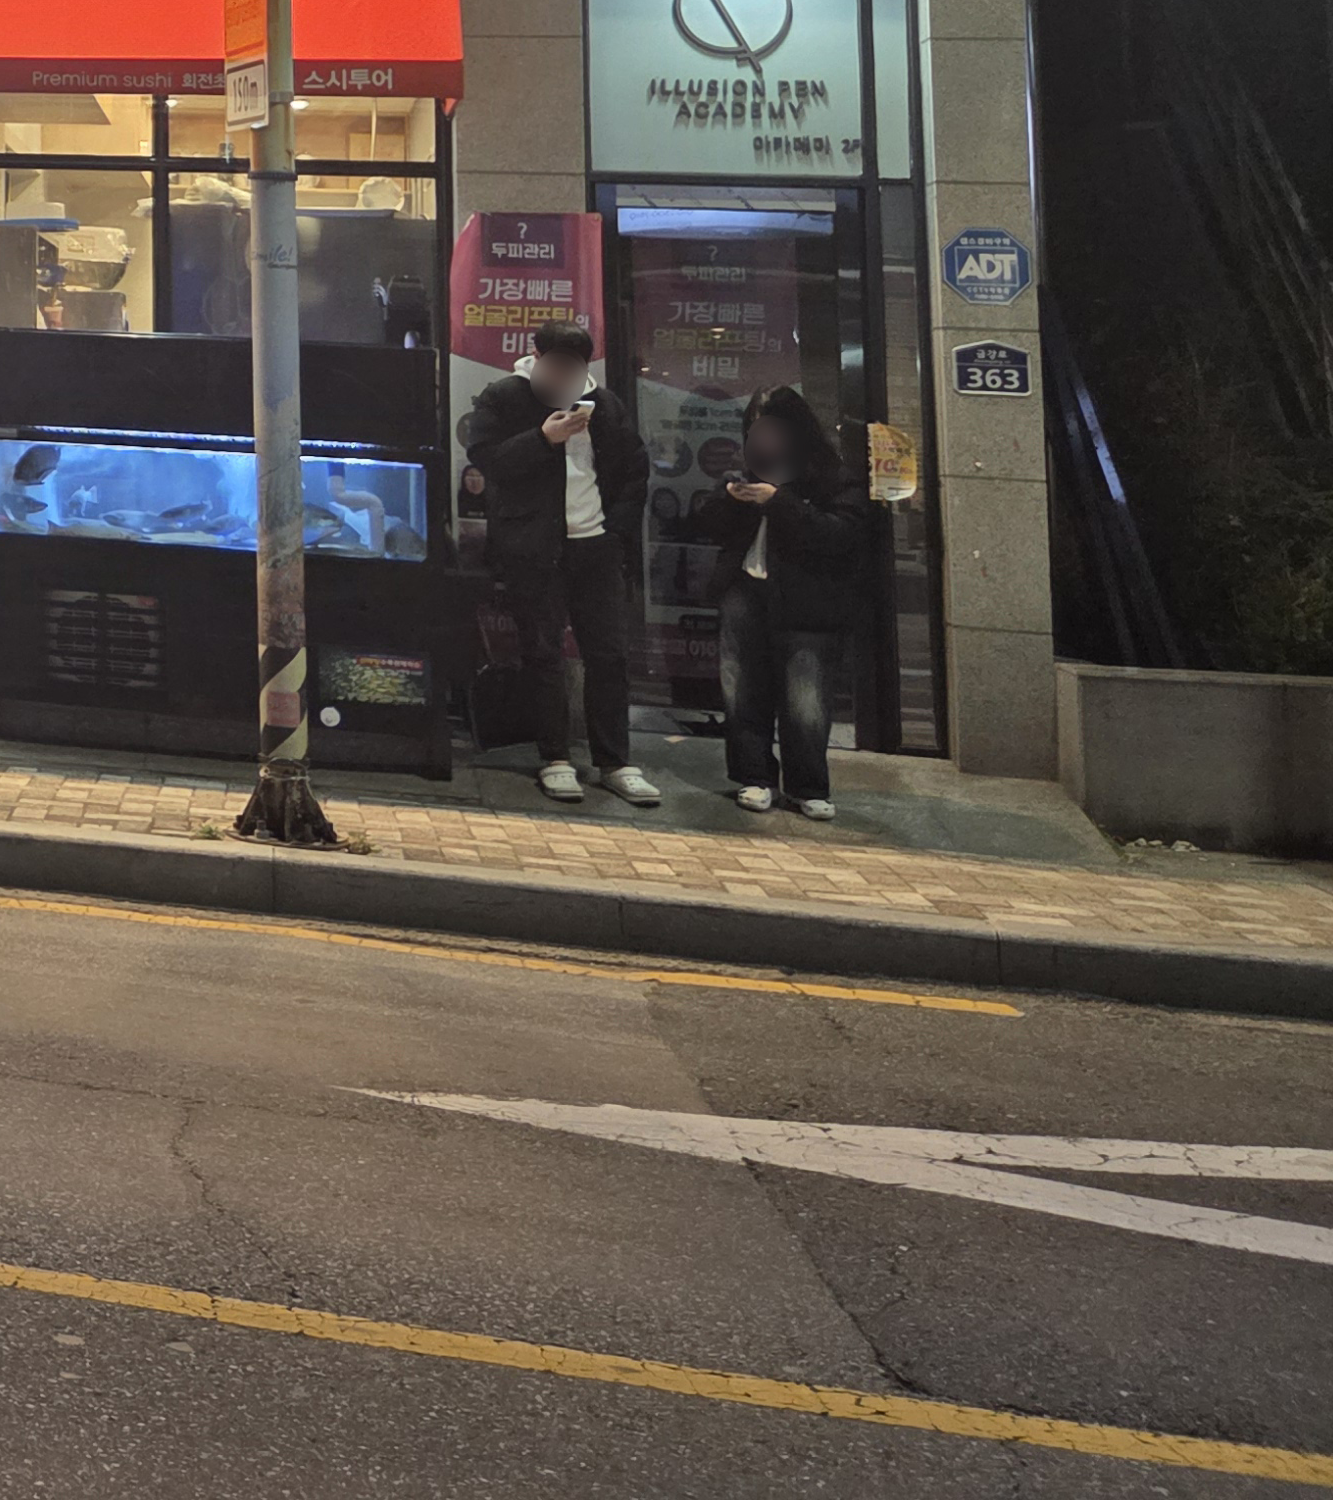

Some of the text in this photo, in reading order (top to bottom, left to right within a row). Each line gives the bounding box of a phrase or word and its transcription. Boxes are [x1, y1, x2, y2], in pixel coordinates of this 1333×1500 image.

[32, 70, 118, 87] Premium
[123, 70, 173, 88] sushi
[303, 68, 393, 92] 스시투어
[650, 78, 827, 98] ILLUSION PEN
[230, 73, 259, 114] 150m
[675, 101, 805, 120] ACADEMY
[491, 242, 555, 260] 두피관리
[957, 253, 1017, 280] ADT
[692, 355, 740, 380] 비밀
[966, 368, 1020, 389] 363
